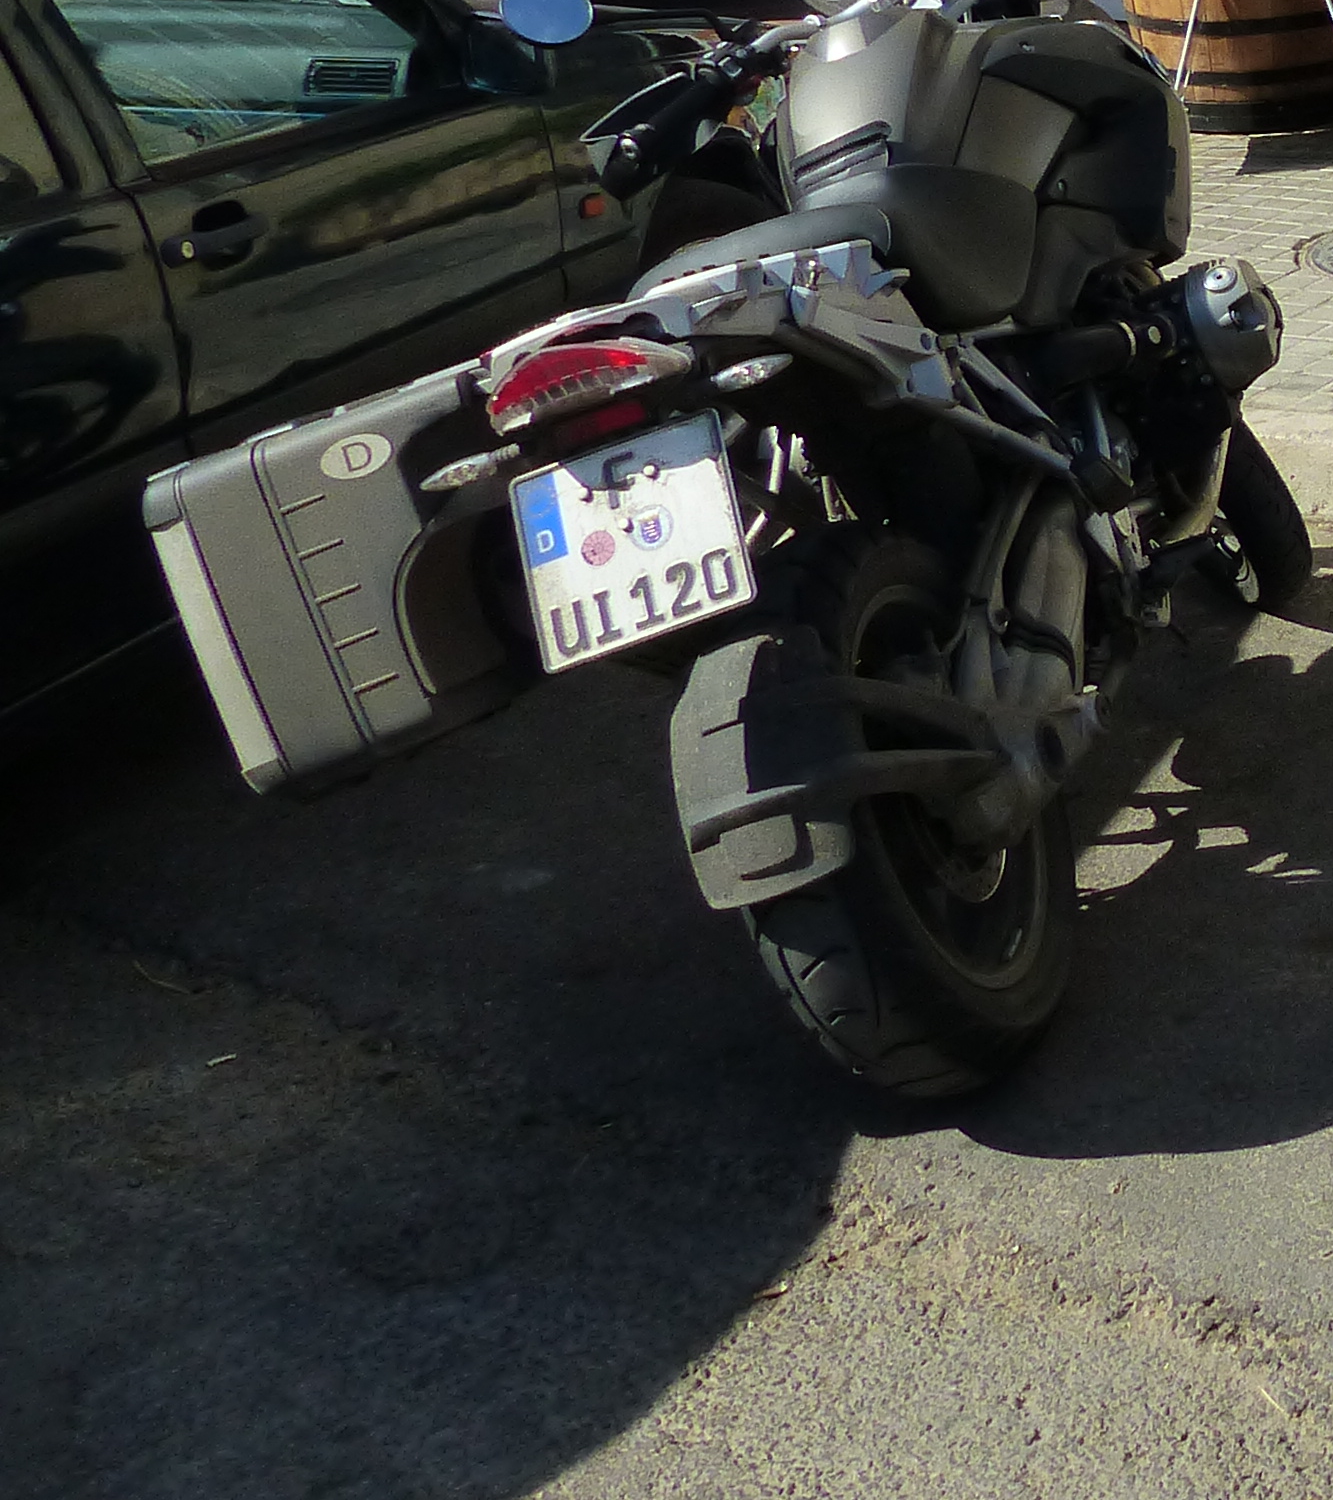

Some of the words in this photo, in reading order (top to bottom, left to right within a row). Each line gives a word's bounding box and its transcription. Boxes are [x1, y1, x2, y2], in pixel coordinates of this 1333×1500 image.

[341, 440, 373, 473] D
[536, 530, 555, 554] D
[629, 547, 737, 630] 120
